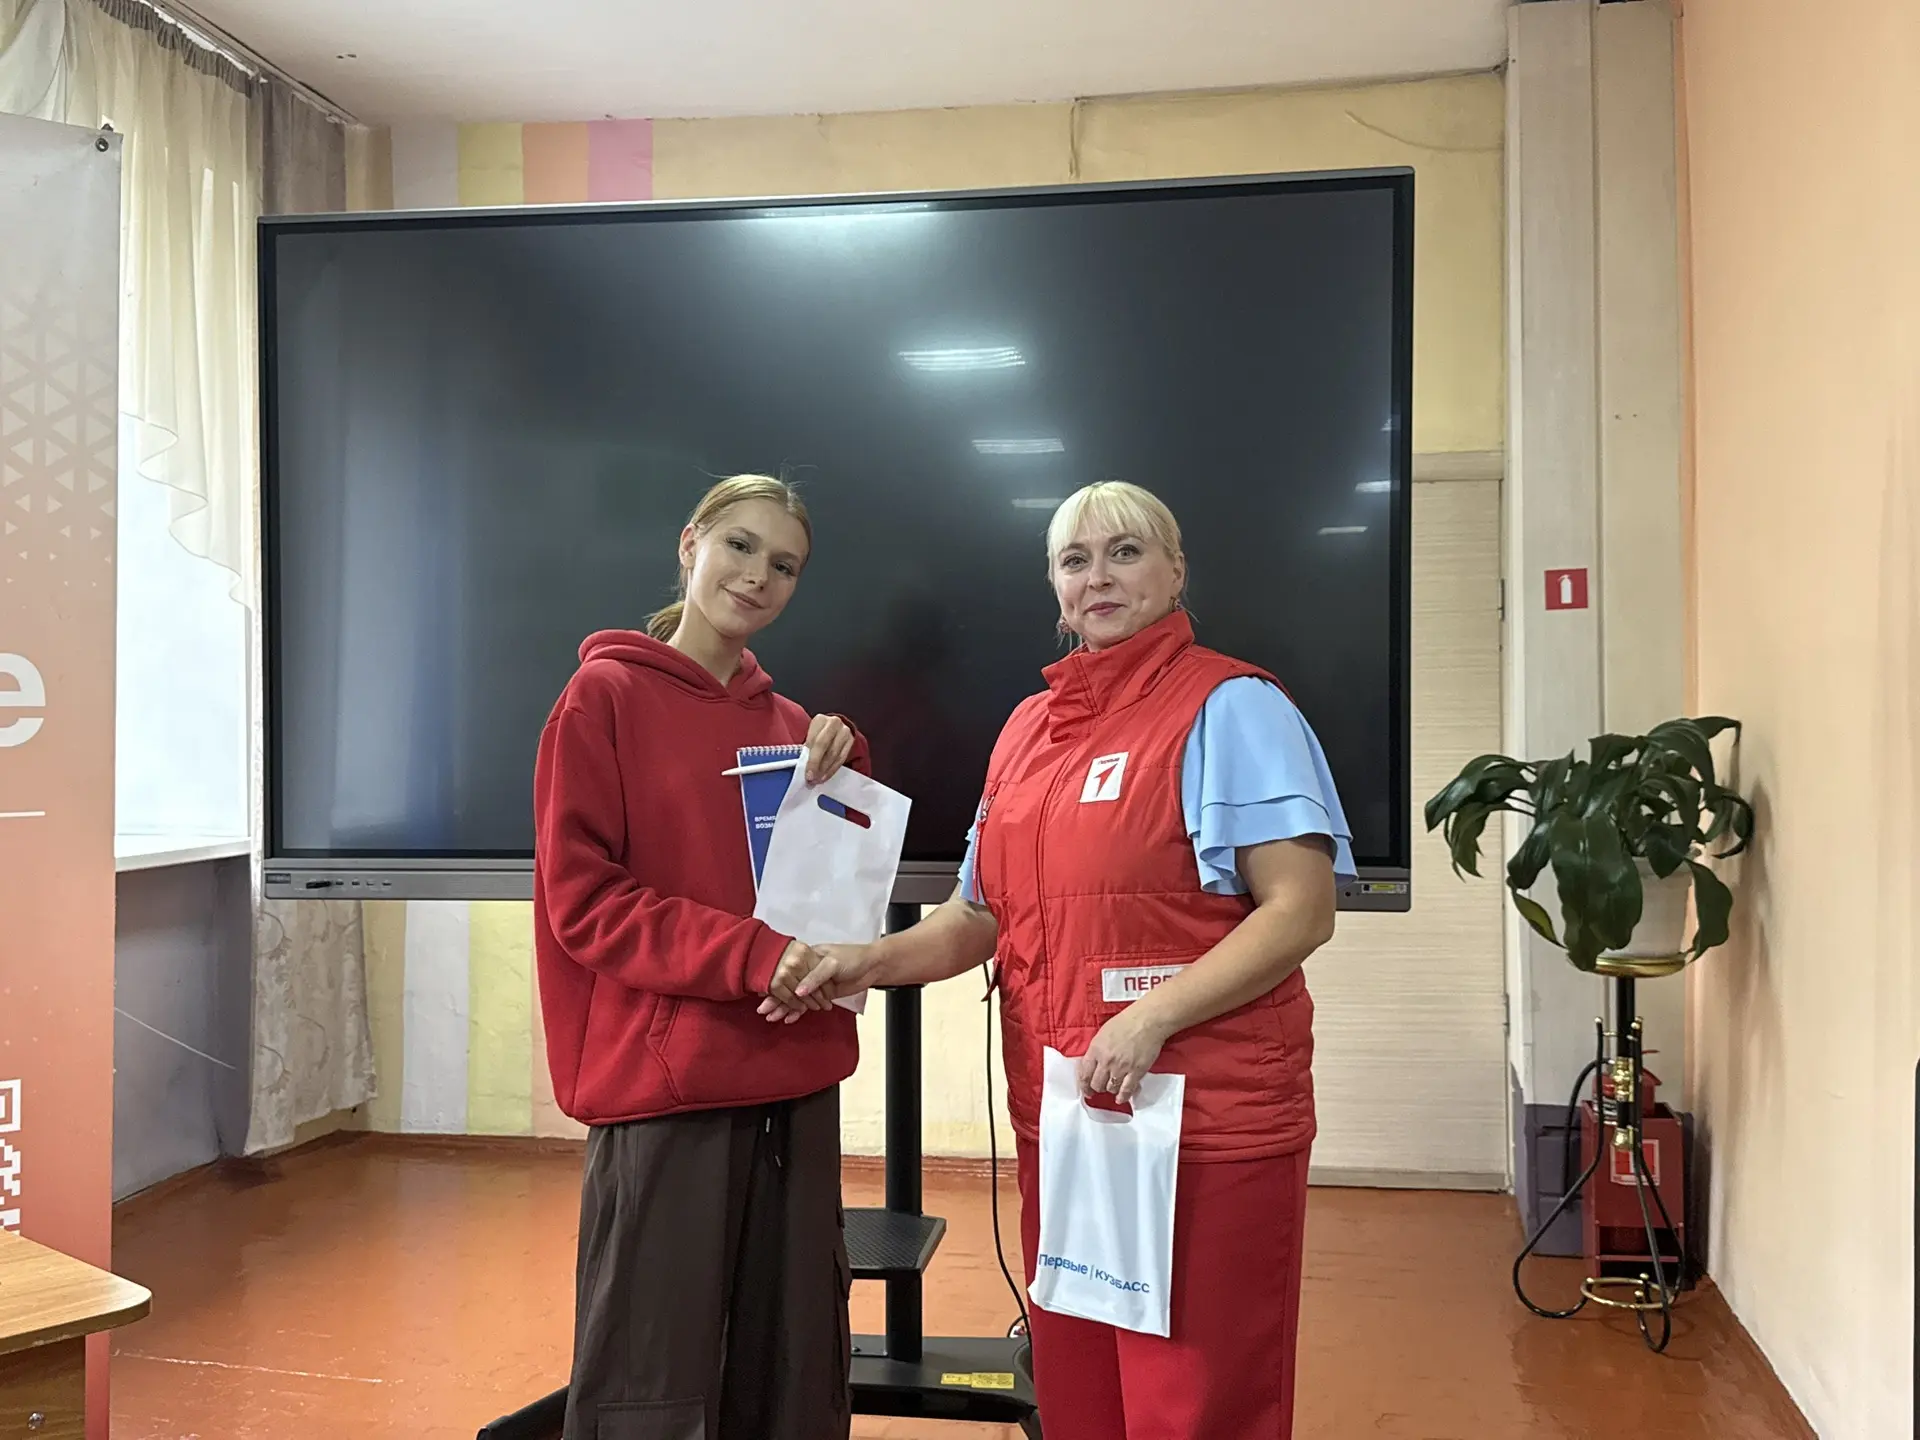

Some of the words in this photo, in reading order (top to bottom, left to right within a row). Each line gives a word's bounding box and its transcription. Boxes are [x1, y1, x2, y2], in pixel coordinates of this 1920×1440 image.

[1124, 975, 1173, 991] ПЕР
[1039, 1254, 1088, 1274] Первые
[1095, 1269, 1150, 1293] КУЗБАСС
